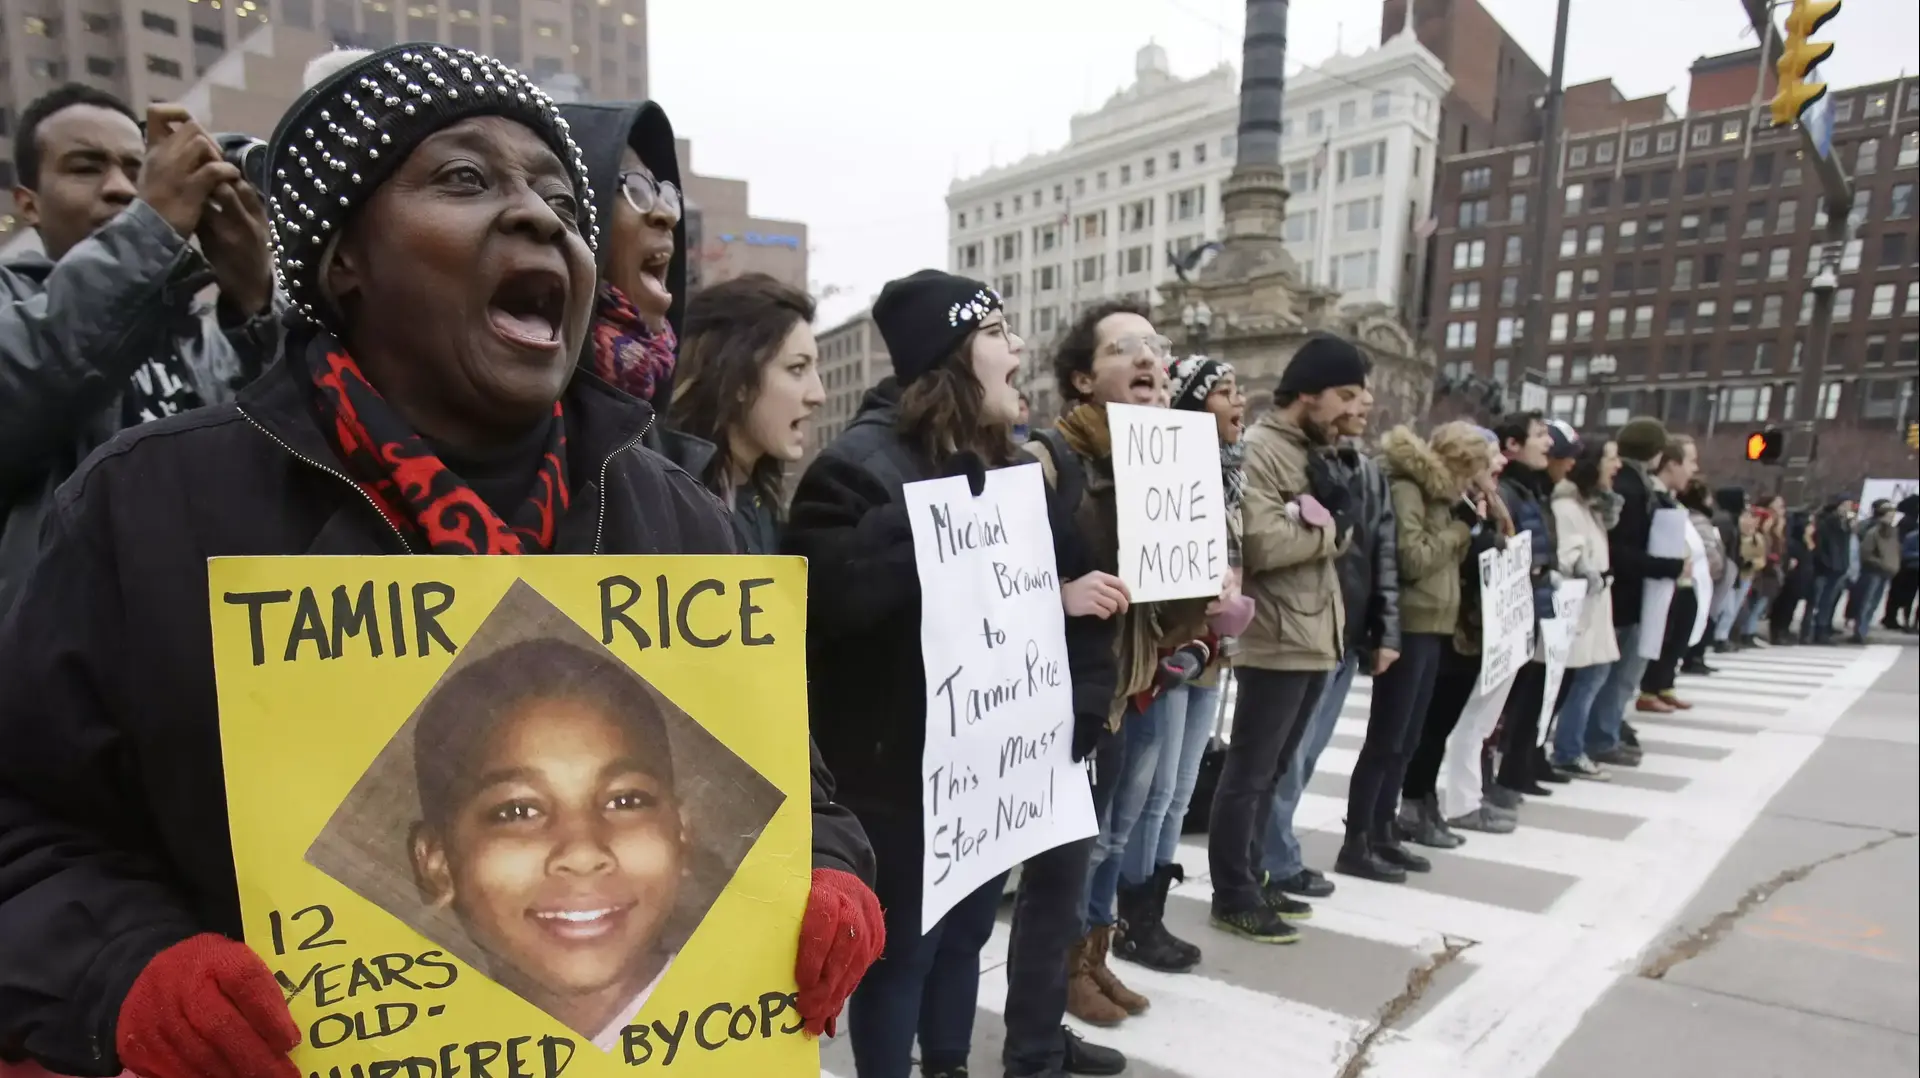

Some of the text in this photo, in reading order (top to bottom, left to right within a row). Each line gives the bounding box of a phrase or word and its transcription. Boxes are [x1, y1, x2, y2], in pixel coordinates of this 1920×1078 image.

[1128, 423, 1183, 466] NOT
[1146, 481, 1206, 522] ONE
[930, 503, 1009, 563] Michael
[993, 561, 1054, 599] Brown
[1139, 539, 1219, 589] MORE
[224, 574, 775, 666] TAMIR RICE
[979, 618, 1006, 648] to
[935, 639, 1061, 737] Tamir Rice
[929, 762, 979, 816] This
[933, 817, 988, 886] Stop
[269, 904, 347, 955] 12
[274, 950, 458, 1007] YEARS
[620, 1010, 689, 1066] BY
